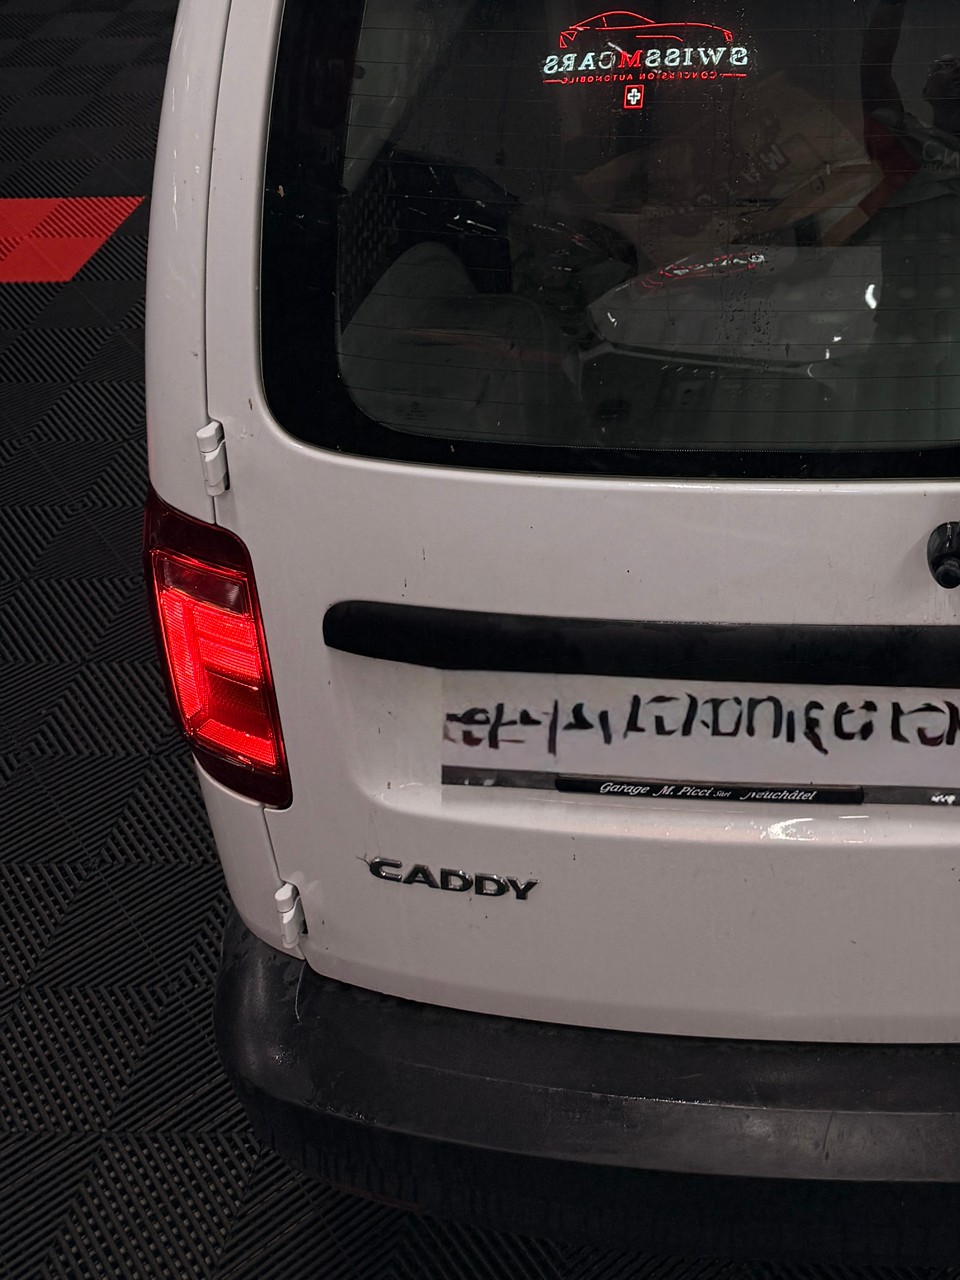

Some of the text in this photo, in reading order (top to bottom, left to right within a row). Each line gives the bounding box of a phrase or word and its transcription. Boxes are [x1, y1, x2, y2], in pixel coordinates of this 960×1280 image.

[599, 782, 650, 796] Garage
[676, 785, 714, 797] Picci
[369, 855, 541, 900] CADDY
